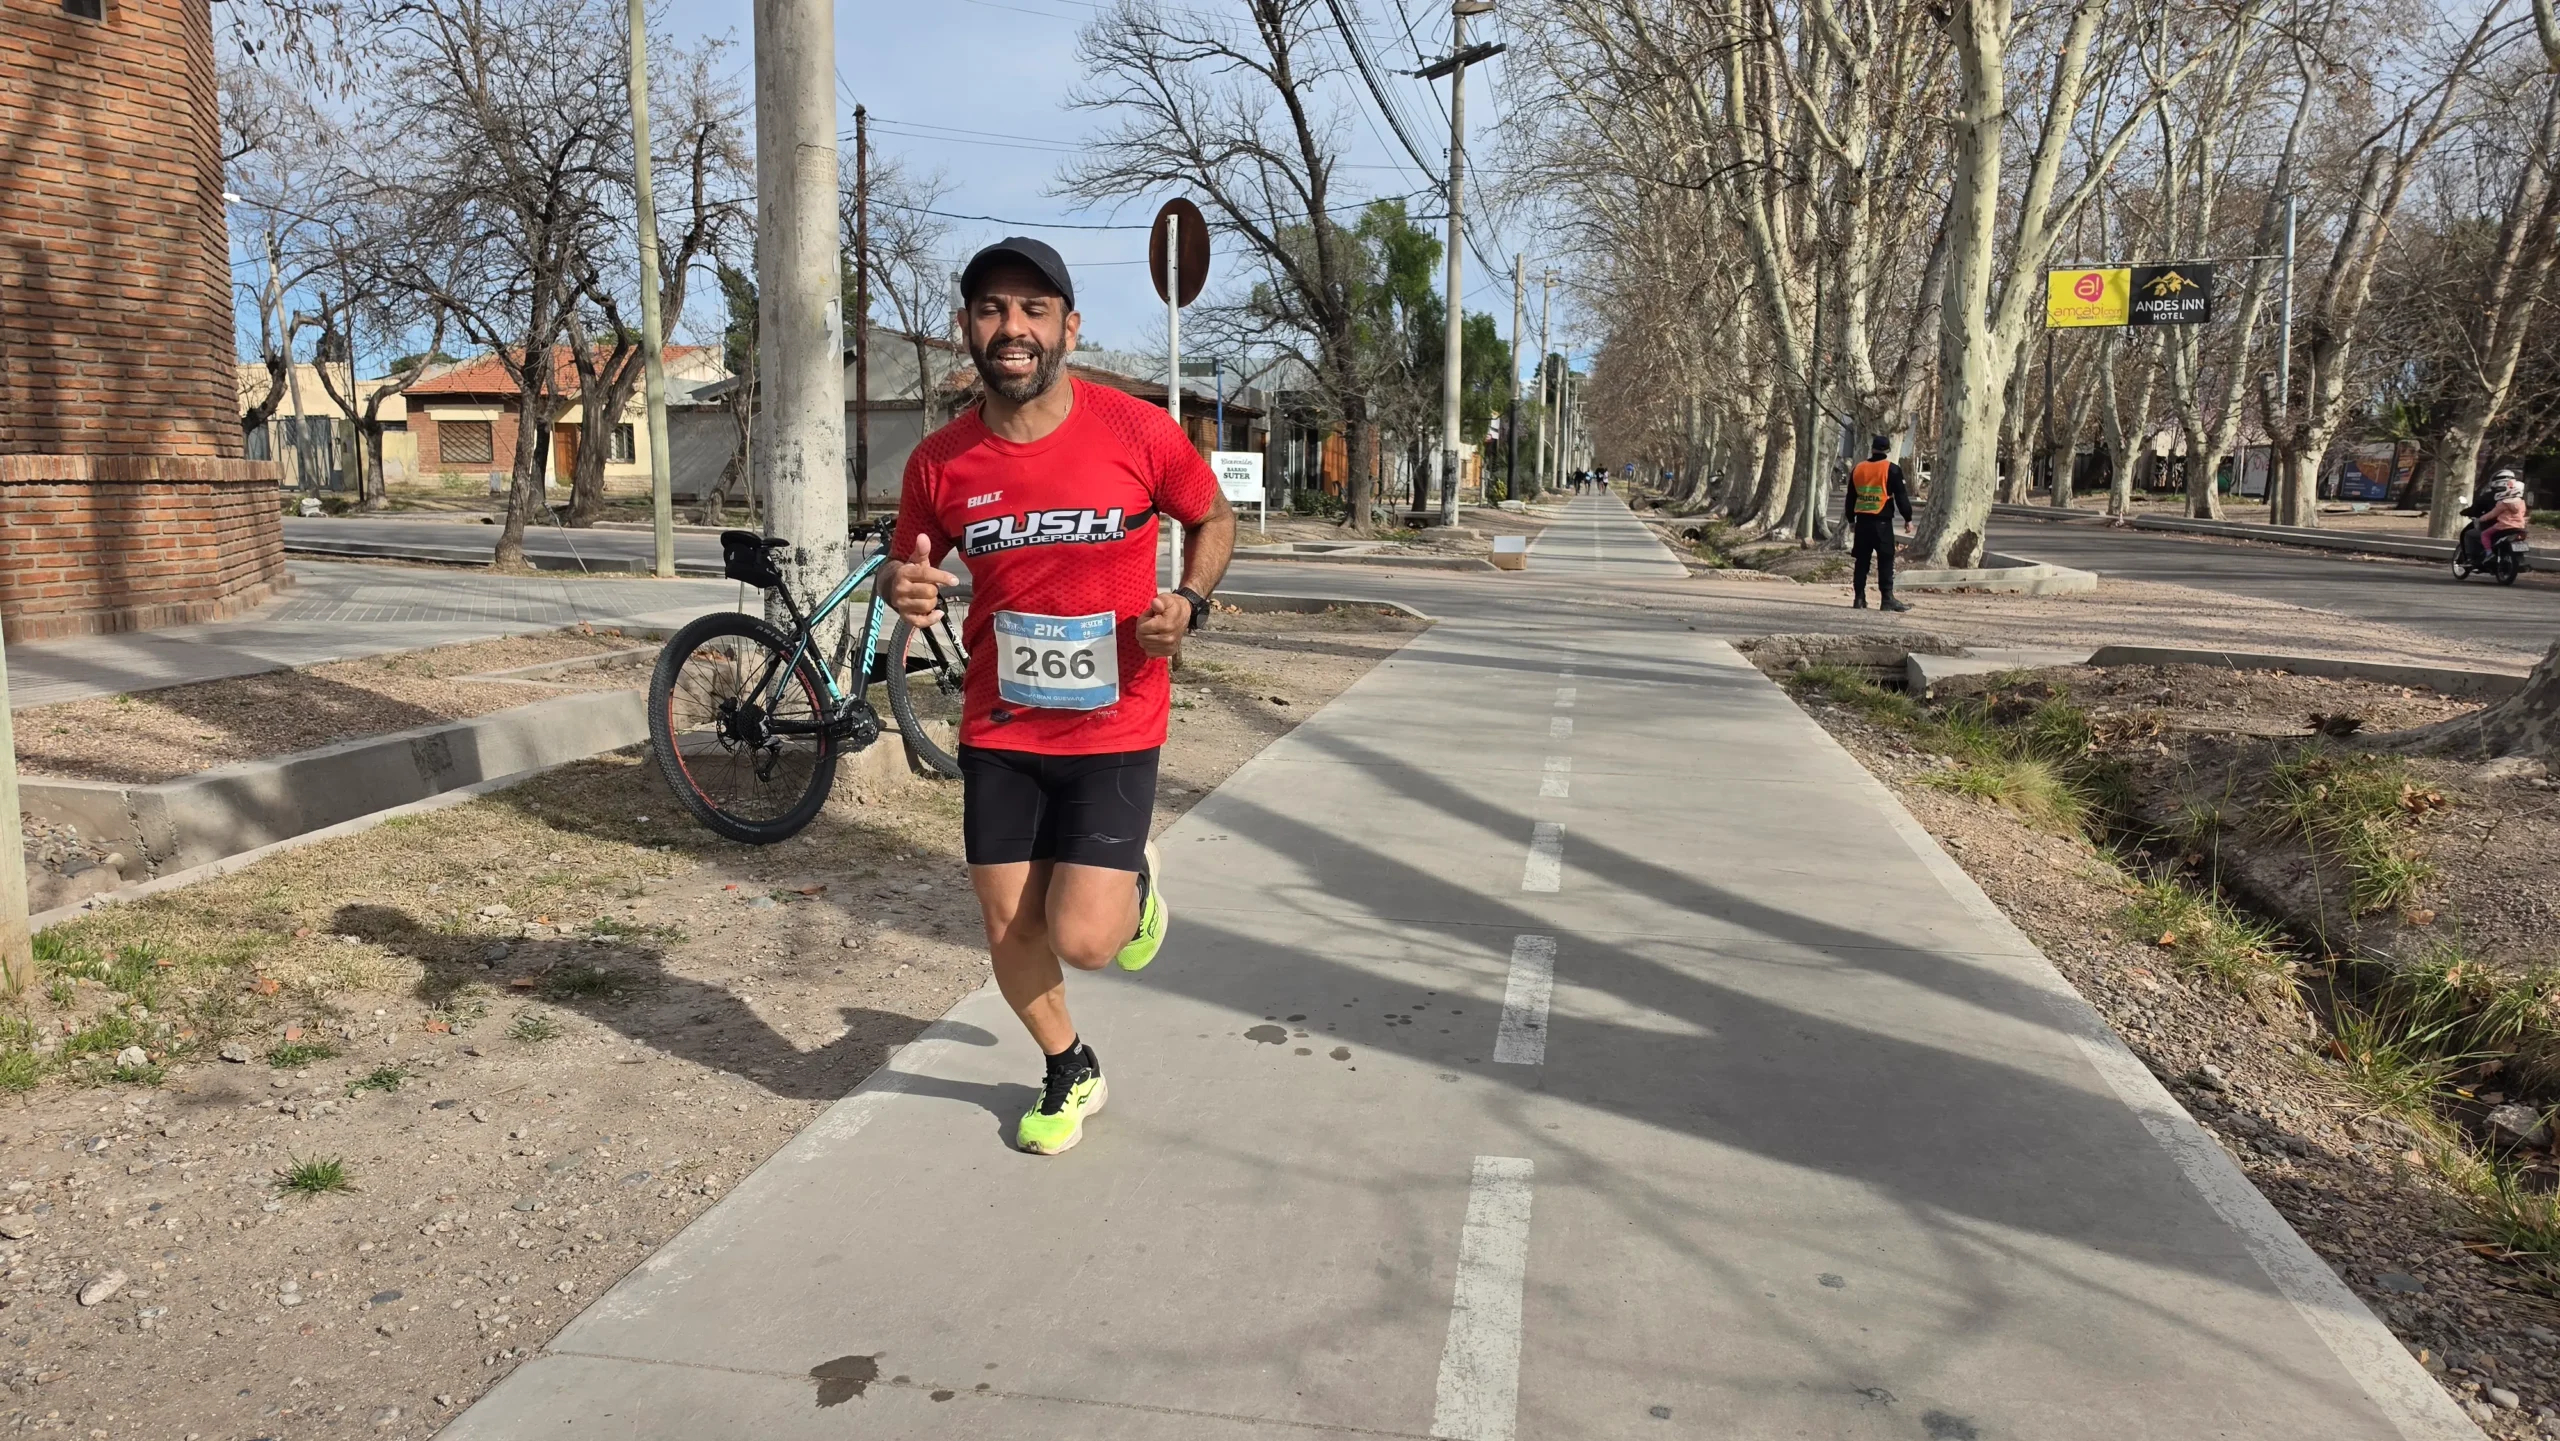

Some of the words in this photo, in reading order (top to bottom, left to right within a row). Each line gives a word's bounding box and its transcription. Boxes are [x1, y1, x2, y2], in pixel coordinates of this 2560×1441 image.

[2135, 300, 2180, 312] ANDES
[2181, 298, 2205, 311] INN
[2153, 312, 2184, 320] HOTEL
[1223, 472, 1250, 480] SUTER
[965, 508, 1122, 548] PUSH
[966, 539, 1024, 556] ACTITUD
[1028, 531, 1124, 543] DEPORTIVA
[1033, 623, 1068, 637] 21K
[1014, 646, 1095, 679] 266
